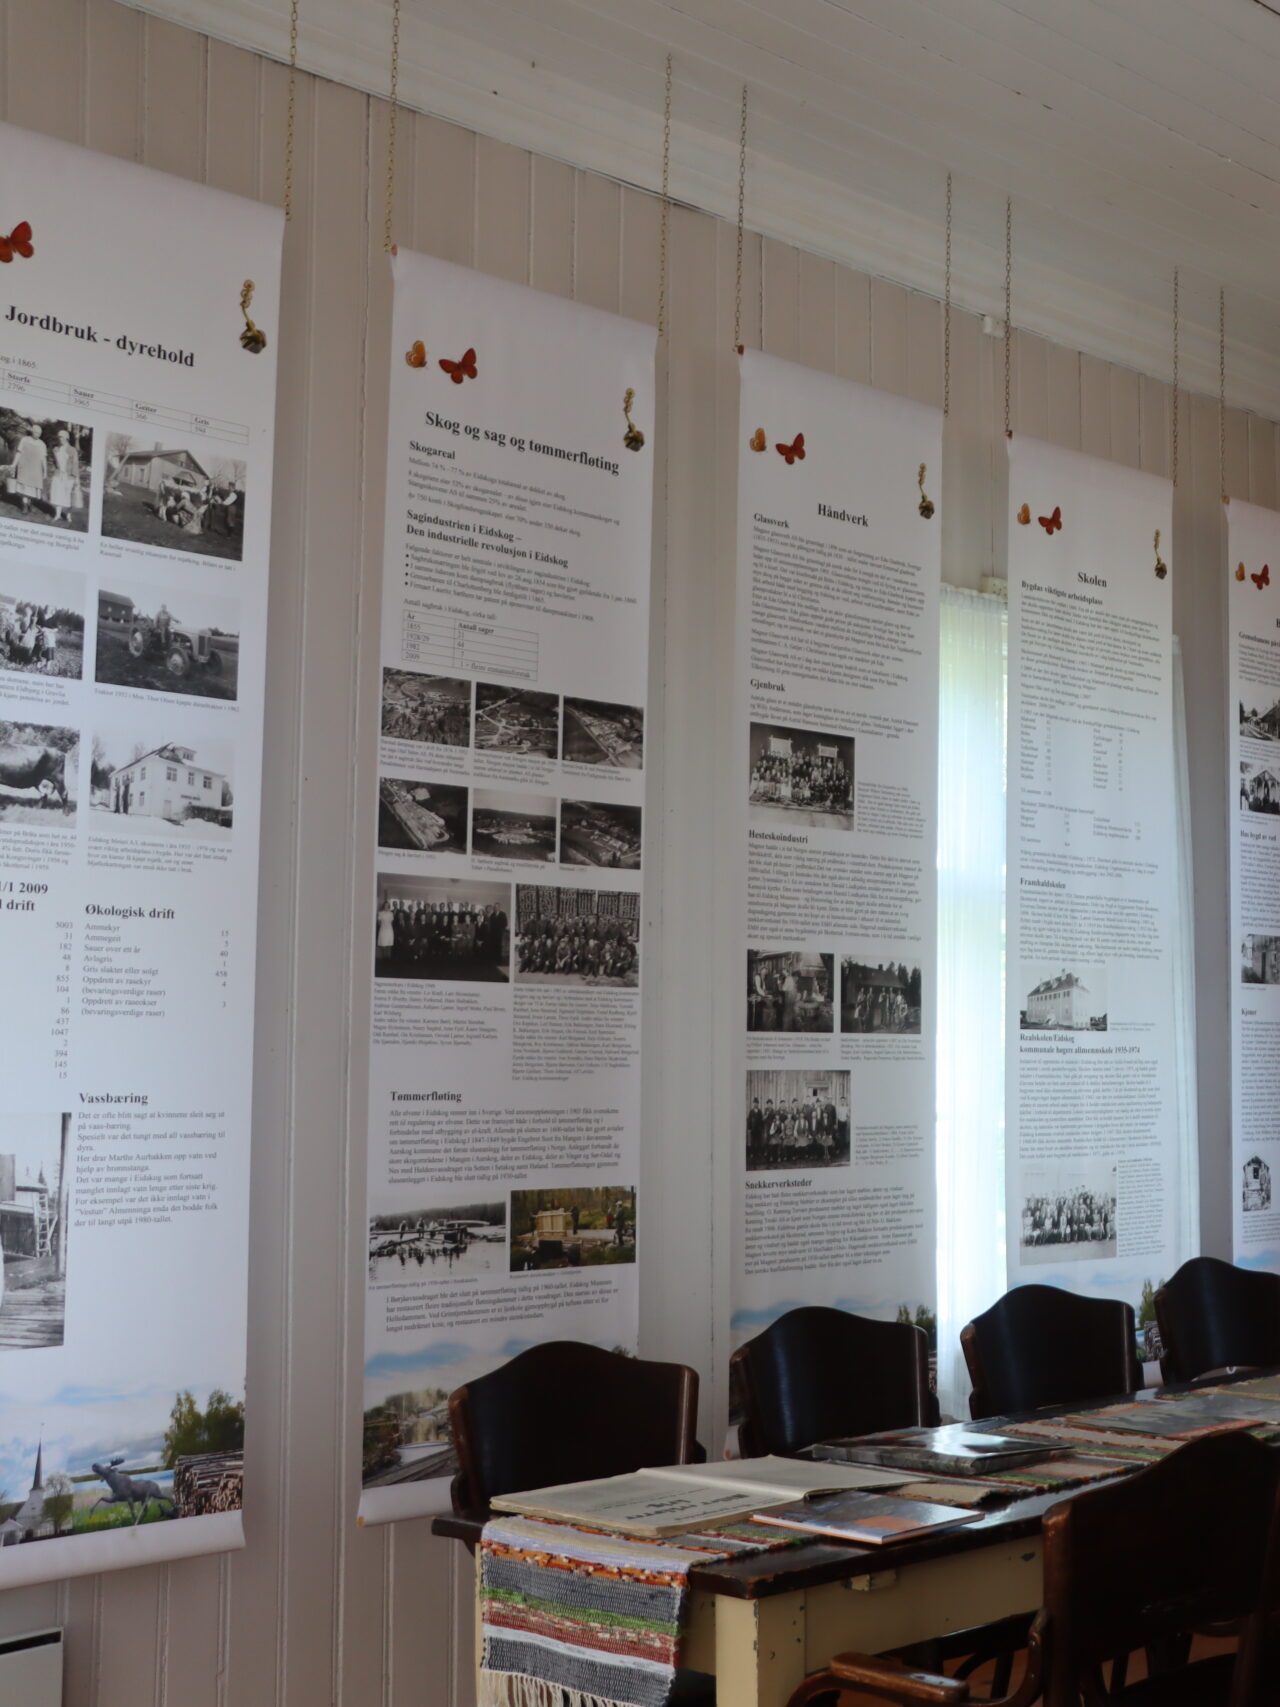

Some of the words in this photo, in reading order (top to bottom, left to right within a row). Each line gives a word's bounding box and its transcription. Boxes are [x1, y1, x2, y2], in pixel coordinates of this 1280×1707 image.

[5, 305, 98, 343] Jordbruk
[117, 335, 194, 367] dyrehold
[410, 440, 455, 459] Skogareal
[425, 411, 460, 435] Skog
[465, 422, 480, 440] og
[484, 428, 506, 447] sag
[510, 434, 525, 451] og
[529, 439, 619, 476] tømmerfløting
[818, 503, 868, 527] Håndverk
[407, 510, 470, 532] Sagindustrien
[473, 523, 477, 533] i
[479, 524, 514, 543] Eidskog
[406, 525, 425, 538] Den
[427, 528, 479, 549] industrielle
[482, 540, 527, 559] revolusjon
[529, 549, 533, 559] i
[535, 550, 568, 567] Eidskog
[1078, 571, 1107, 588] Skolen
[750, 678, 785, 693] Gjenbruk
[20, 882, 48, 894] 2009
[7, 900, 35, 912] drift
[86, 903, 145, 920] Økologisk
[149, 905, 175, 920] drift
[80, 1092, 148, 1106] Vassbæring
[390, 1091, 462, 1103] Tømmerfløting
